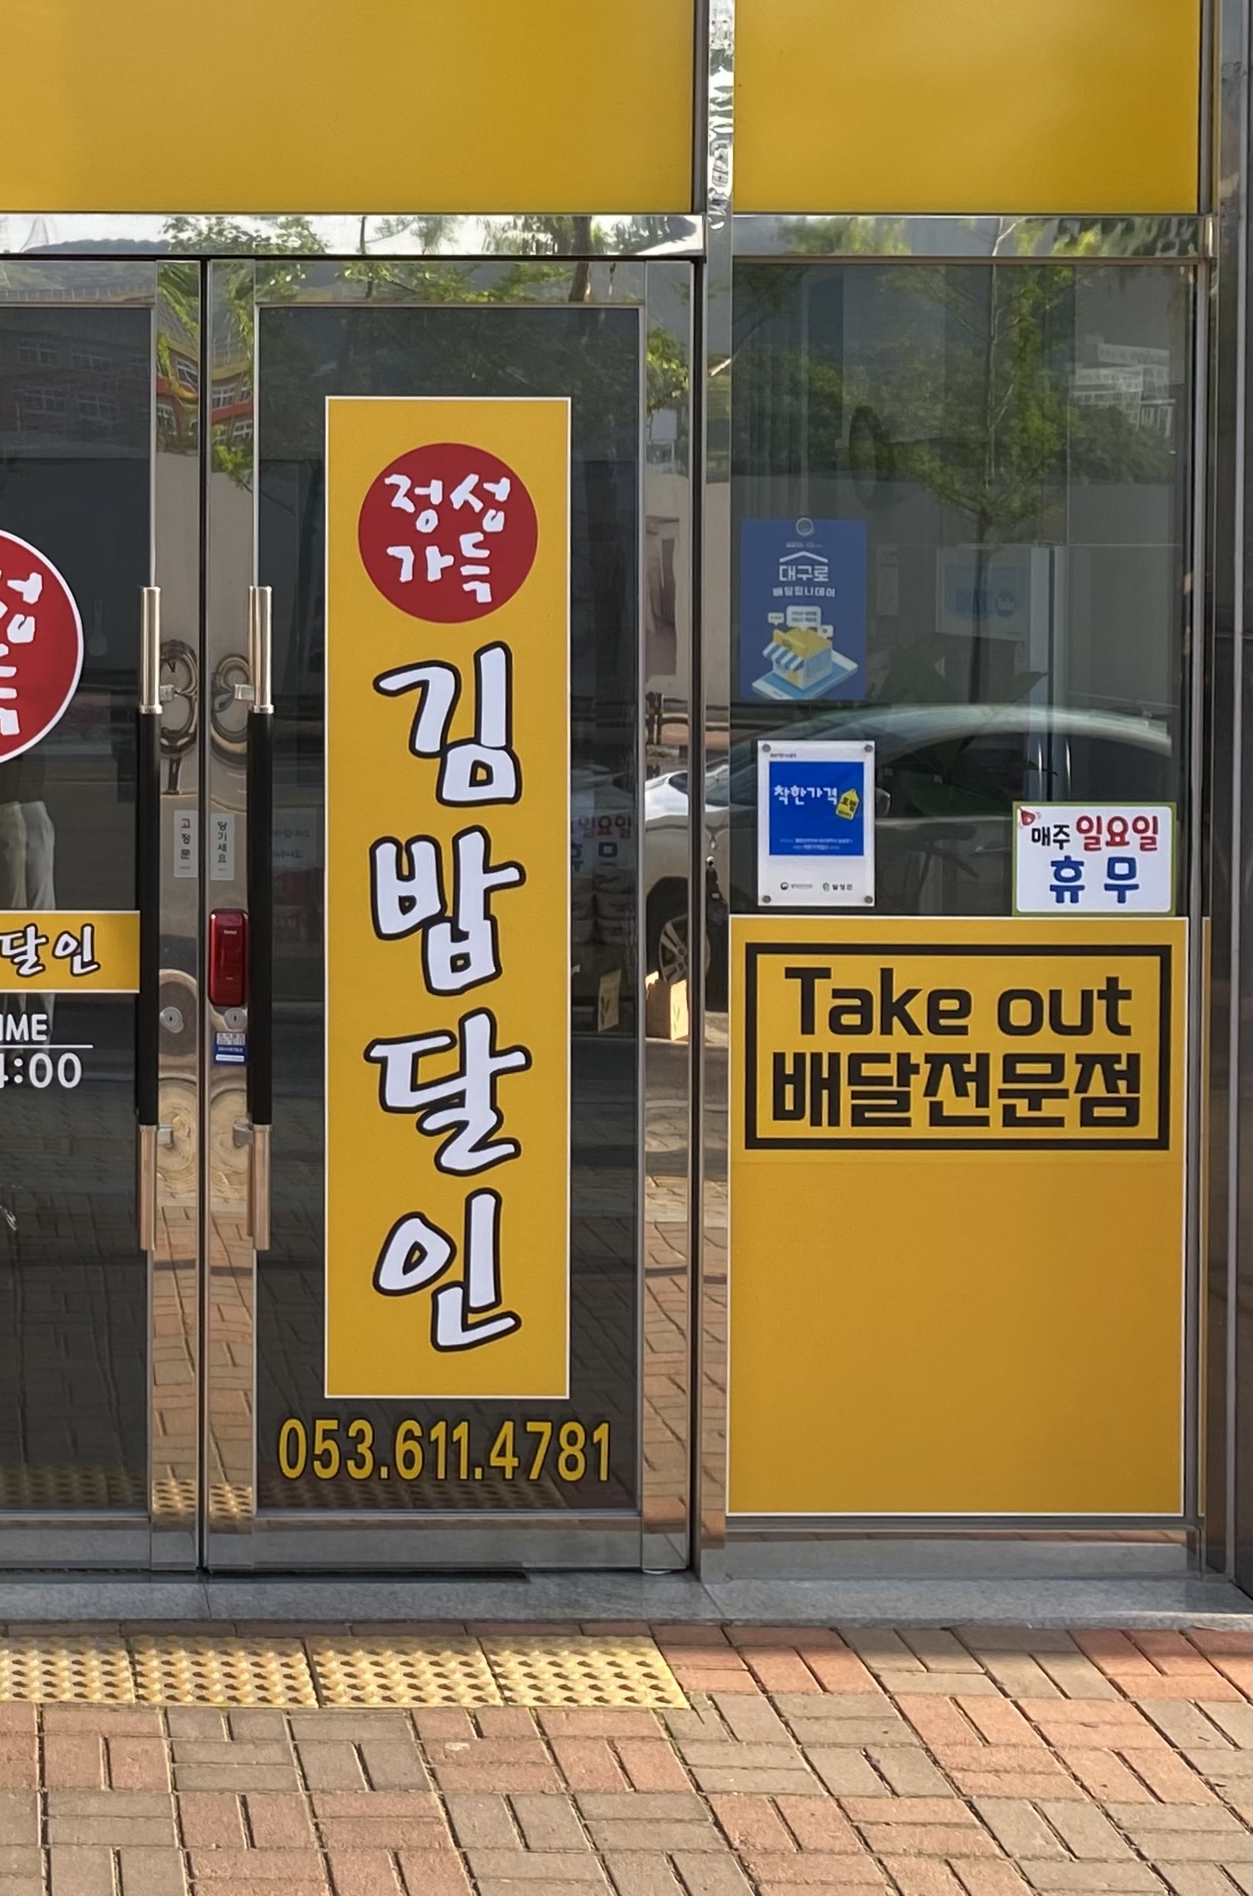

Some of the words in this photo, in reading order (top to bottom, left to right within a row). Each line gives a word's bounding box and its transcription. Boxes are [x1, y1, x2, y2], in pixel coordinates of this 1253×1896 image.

[384, 473, 510, 533] 정성
[386, 532, 492, 603] 가득
[779, 565, 829, 582] 대구로
[774, 784, 838, 805] 착한가격
[180, 817, 191, 860] 고정문
[216, 820, 228, 864] 당기세요
[1031, 824, 1071, 850] 매주
[1076, 815, 1159, 851] 일요일
[364, 641, 532, 1352] 김밥달인
[784, 966, 973, 1036] Take
[997, 976, 1132, 1036] out
[772, 1051, 1141, 1128] 배달전문점
[278, 1417, 612, 1483] 053.611.4781
